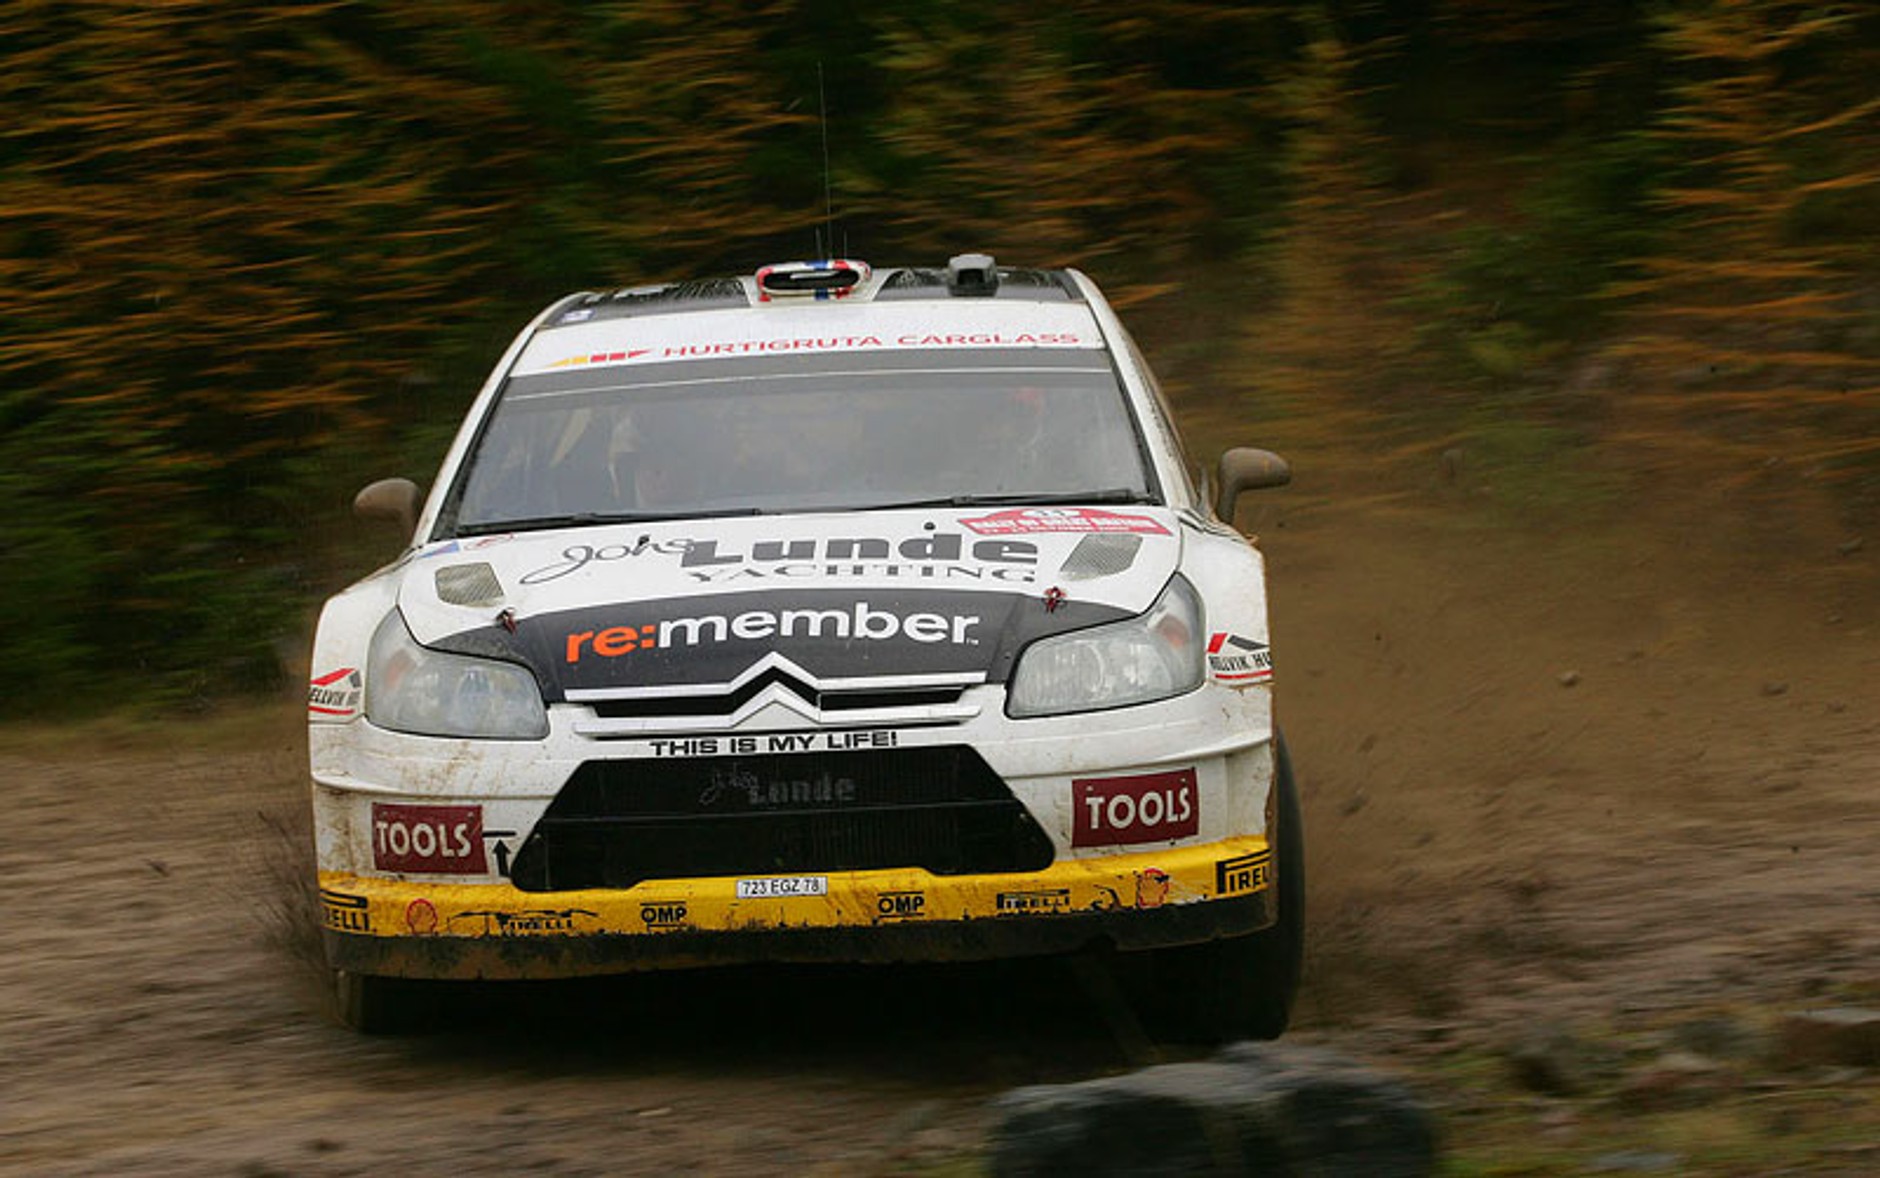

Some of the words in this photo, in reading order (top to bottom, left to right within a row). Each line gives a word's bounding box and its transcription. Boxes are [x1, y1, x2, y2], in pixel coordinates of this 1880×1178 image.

[664, 335, 882, 357] HURTIGRUTA
[897, 333, 1080, 345] CARGLASS
[681, 533, 1038, 567] Lunde
[687, 565, 1035, 583] YACHTING
[649, 738, 718, 756] THIS
[730, 737, 757, 754] IS
[768, 735, 815, 752] MY
[827, 731, 898, 749] LIFE!
[1085, 786, 1191, 830] TOOLS
[376, 820, 472, 858] TOOLS
[742, 880, 768, 895] 723
[771, 878, 800, 894] EGZ
[804, 877, 820, 893] 78
[640, 905, 688, 923] OMP
[878, 895, 925, 913] OMP
